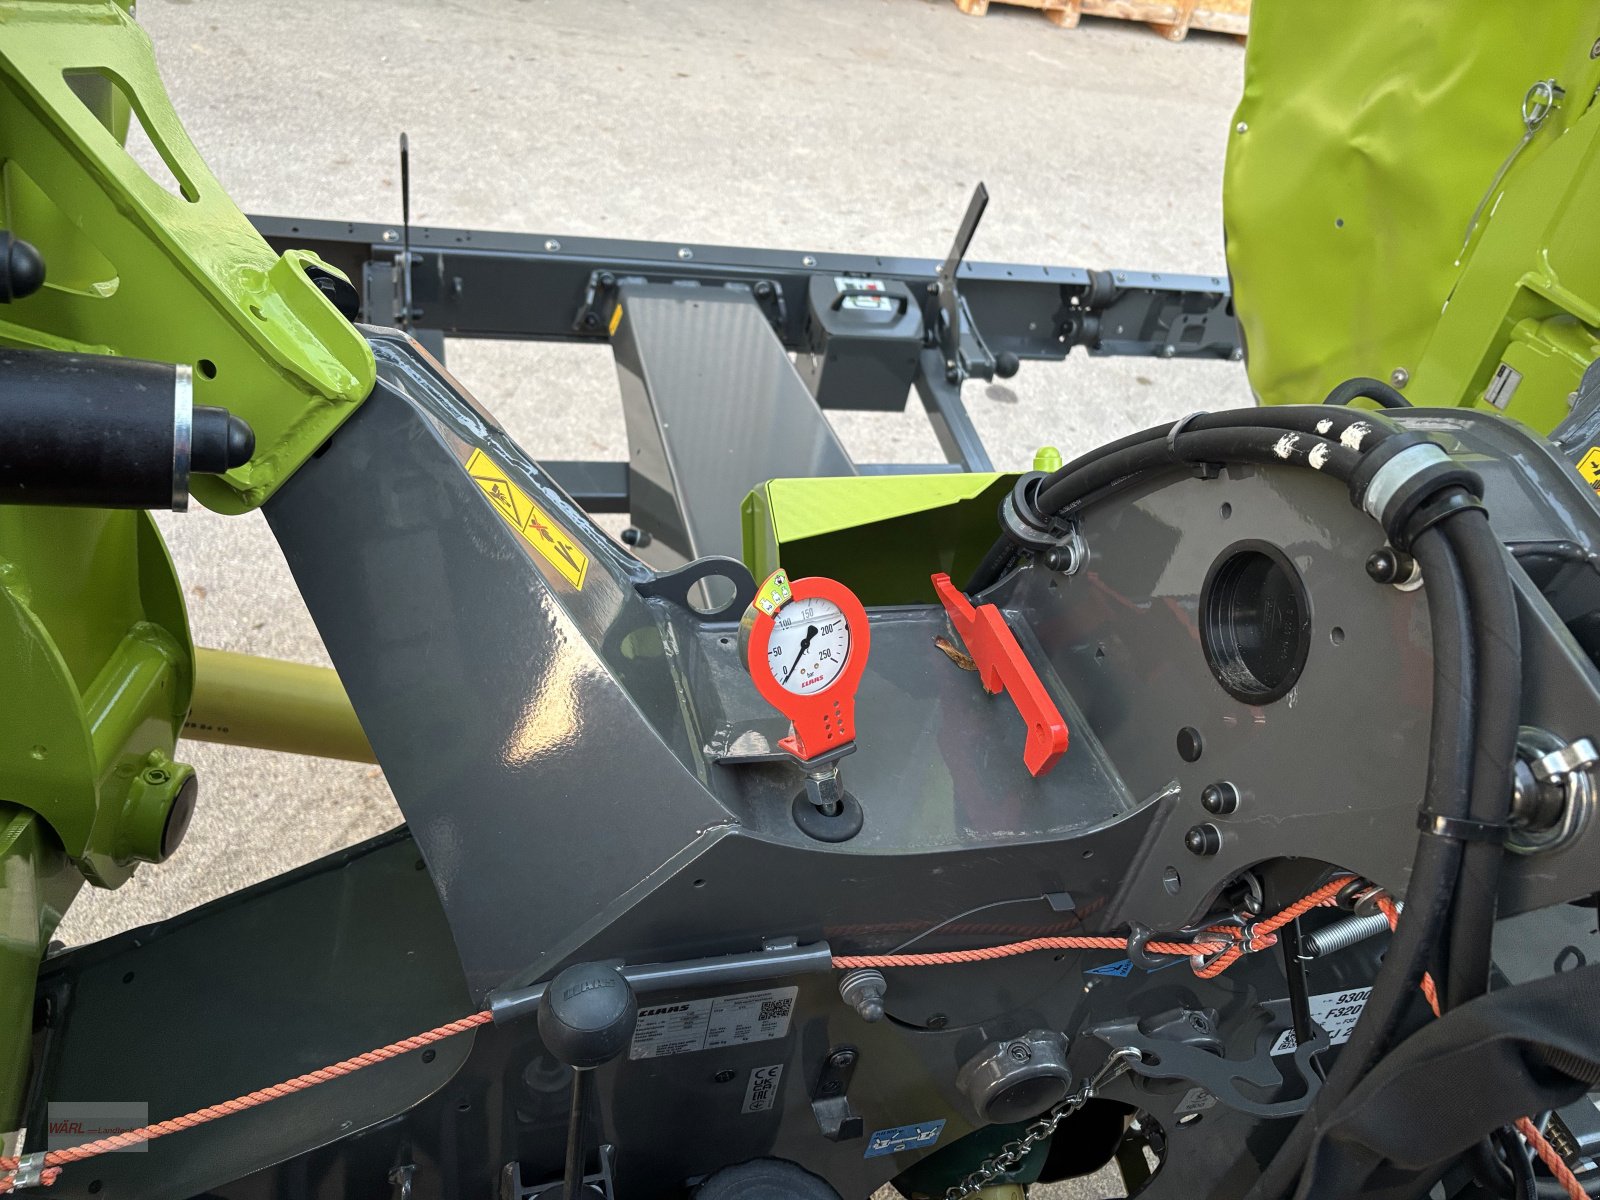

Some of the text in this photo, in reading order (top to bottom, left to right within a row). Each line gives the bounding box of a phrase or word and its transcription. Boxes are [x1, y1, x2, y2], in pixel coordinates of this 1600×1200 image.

[801, 607, 814, 620] 150
[779, 618, 792, 628] 100
[820, 623, 834, 636] 200
[772, 646, 782, 656] 50
[818, 648, 832, 660] 250
[783, 665, 788, 675] 0
[801, 675, 824, 688] CLAAS
[638, 1004, 690, 1018] CLAAS
